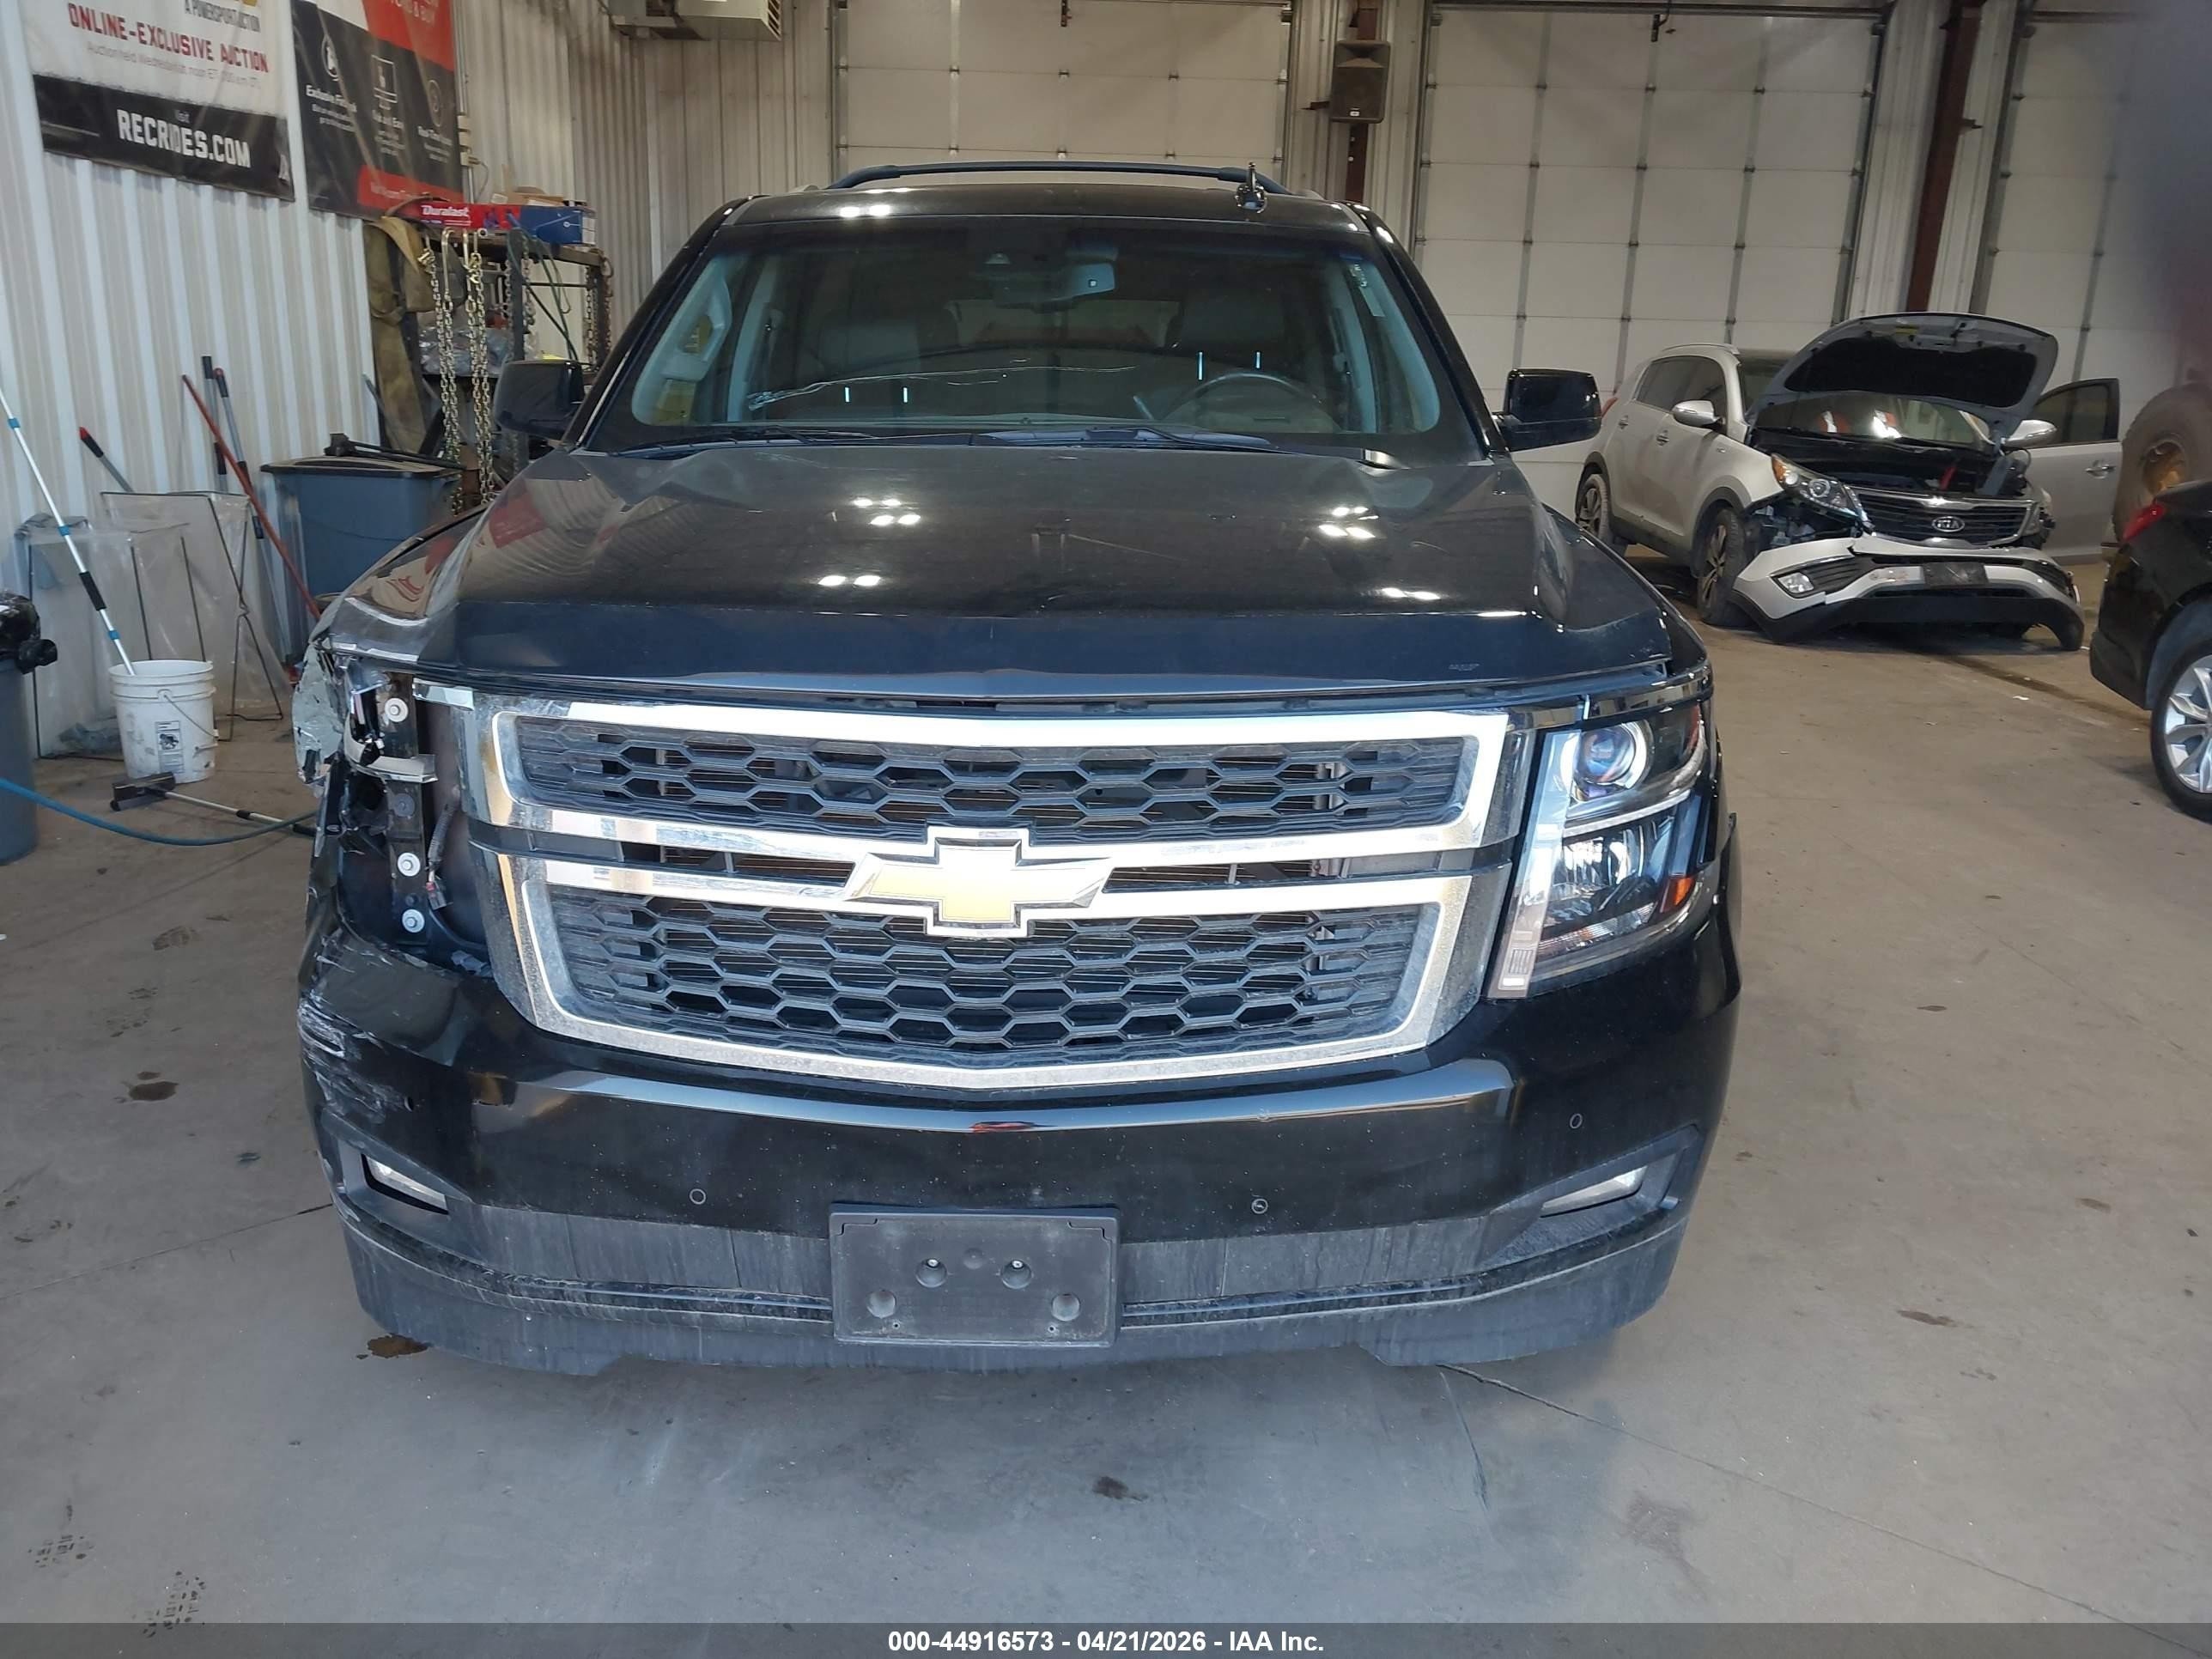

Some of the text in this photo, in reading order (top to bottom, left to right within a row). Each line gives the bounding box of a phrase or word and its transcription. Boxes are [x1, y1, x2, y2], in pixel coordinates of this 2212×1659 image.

[68, 3, 214, 61] ONLINE-EXCLUSIVE
[220, 43, 269, 73] AUCTION
[117, 109, 251, 168] RECRIDES.COM
